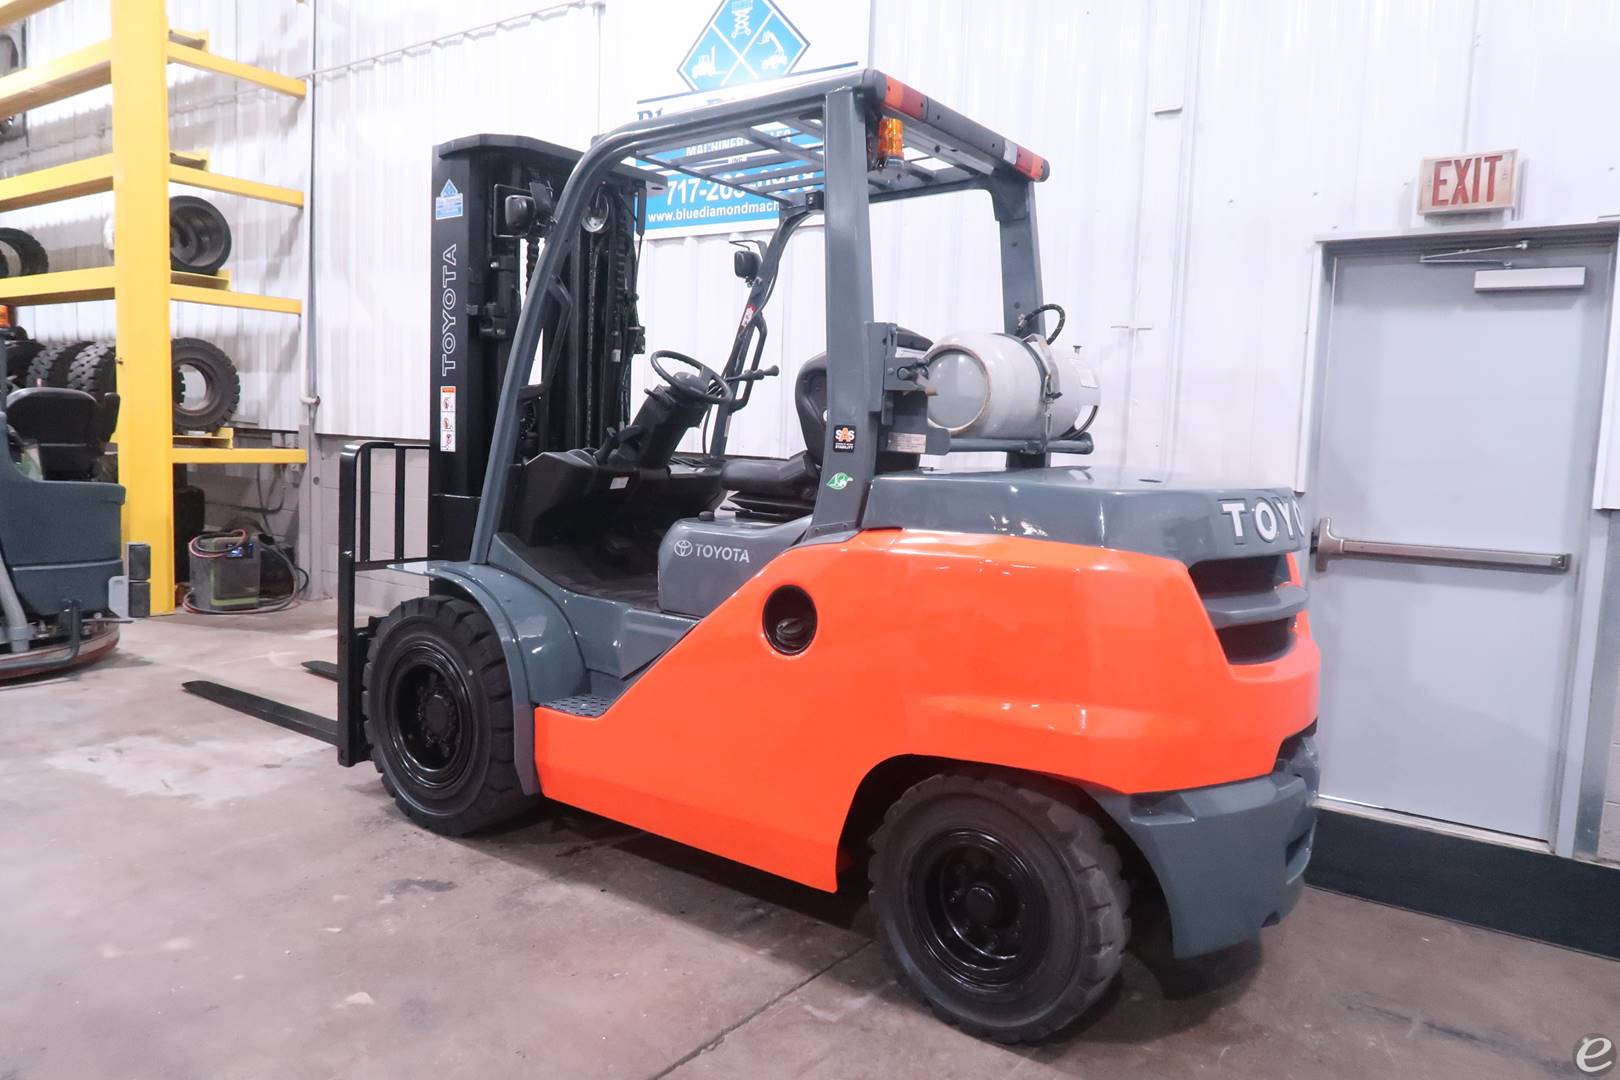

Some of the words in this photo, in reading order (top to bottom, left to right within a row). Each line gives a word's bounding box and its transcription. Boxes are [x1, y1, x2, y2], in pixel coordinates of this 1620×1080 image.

[1432, 155, 1503, 207] EXIT
[442, 243, 457, 377] TOYOTA
[835, 427, 855, 442] SAS
[695, 543, 750, 563] TOYOTA
